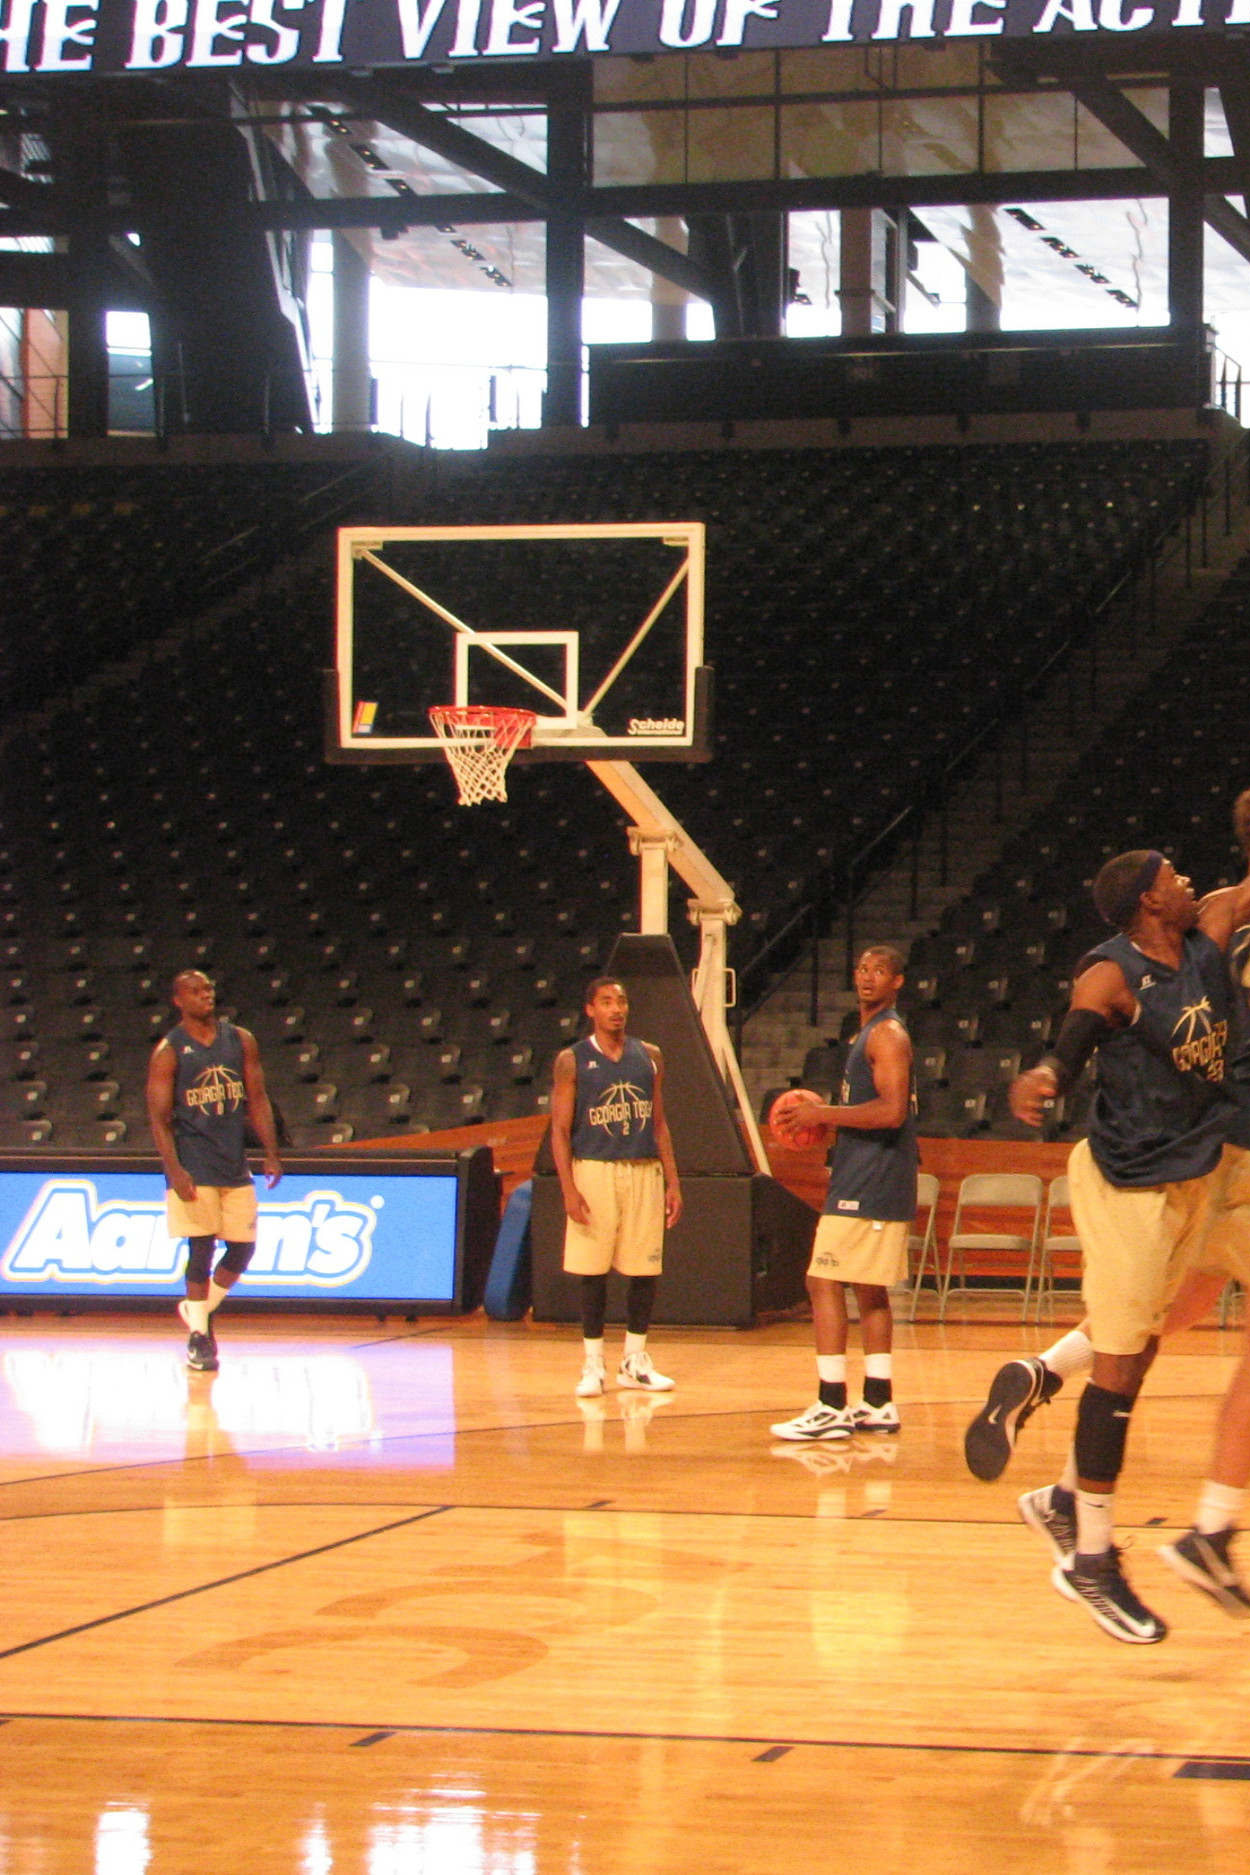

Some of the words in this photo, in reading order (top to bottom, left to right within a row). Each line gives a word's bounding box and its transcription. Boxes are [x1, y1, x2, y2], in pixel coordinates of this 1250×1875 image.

[125, 0, 346, 69] BEST
[396, 0, 624, 59] VIEW
[589, 1102, 631, 1127] GEORGIA
[8, 1184, 370, 1280] Aarn's
